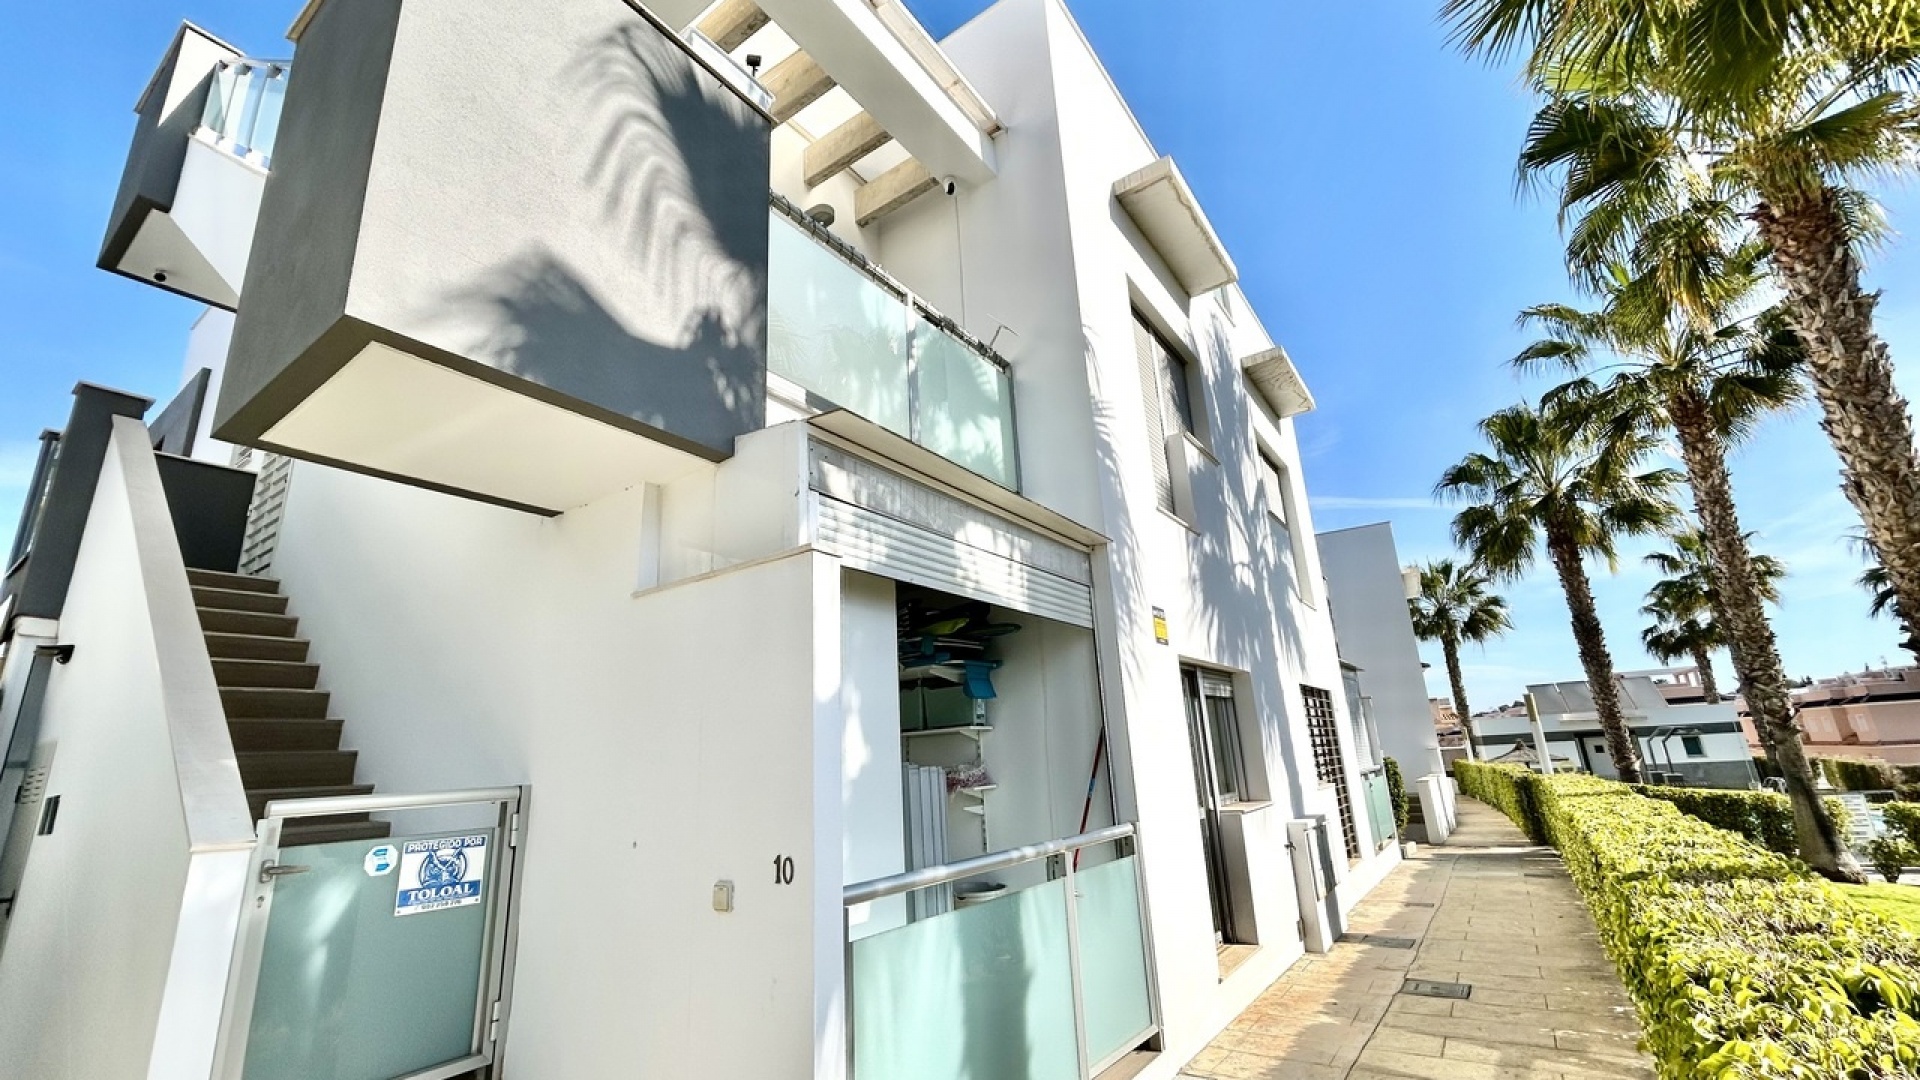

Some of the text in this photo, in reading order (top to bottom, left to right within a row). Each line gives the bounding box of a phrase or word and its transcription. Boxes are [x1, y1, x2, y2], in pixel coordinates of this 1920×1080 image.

[408, 836, 482, 852] PROTEGIDO POR
[773, 854, 794, 885] 10
[408, 883, 473, 901] TOLOAL
